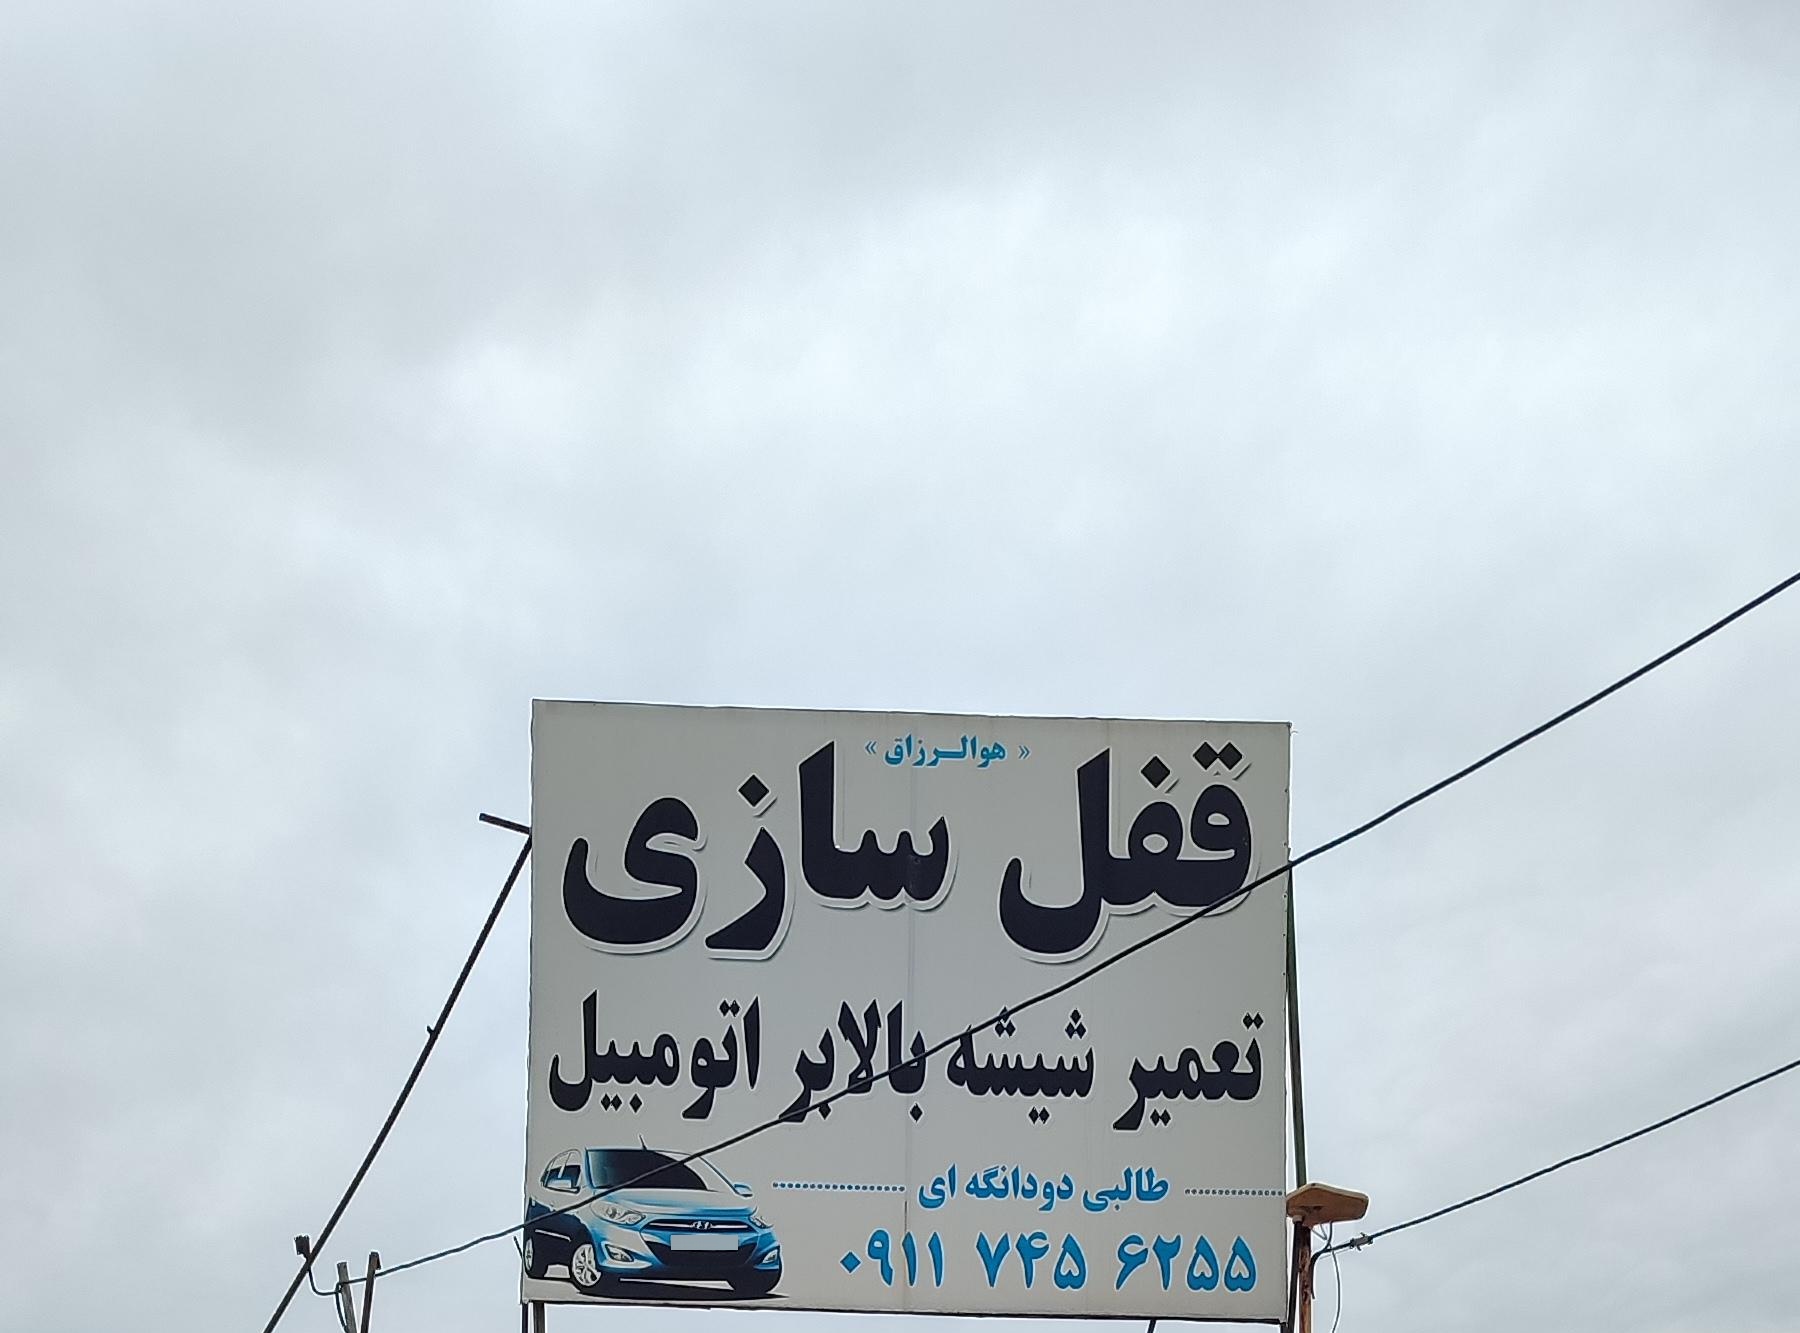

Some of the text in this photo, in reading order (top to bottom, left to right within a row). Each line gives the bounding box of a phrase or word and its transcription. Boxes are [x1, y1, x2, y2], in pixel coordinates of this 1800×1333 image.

[562, 741, 1253, 954] قفل سازی
[549, 990, 1264, 1130] تعمیر شیشه بالابر اتومبیل
[918, 1163, 957, 1209] ای
[1083, 1166, 1169, 1212] طالبی
[839, 1229, 1257, 1292] ۰۹۱۱ ۷۴۵ ۶۲۵۵
